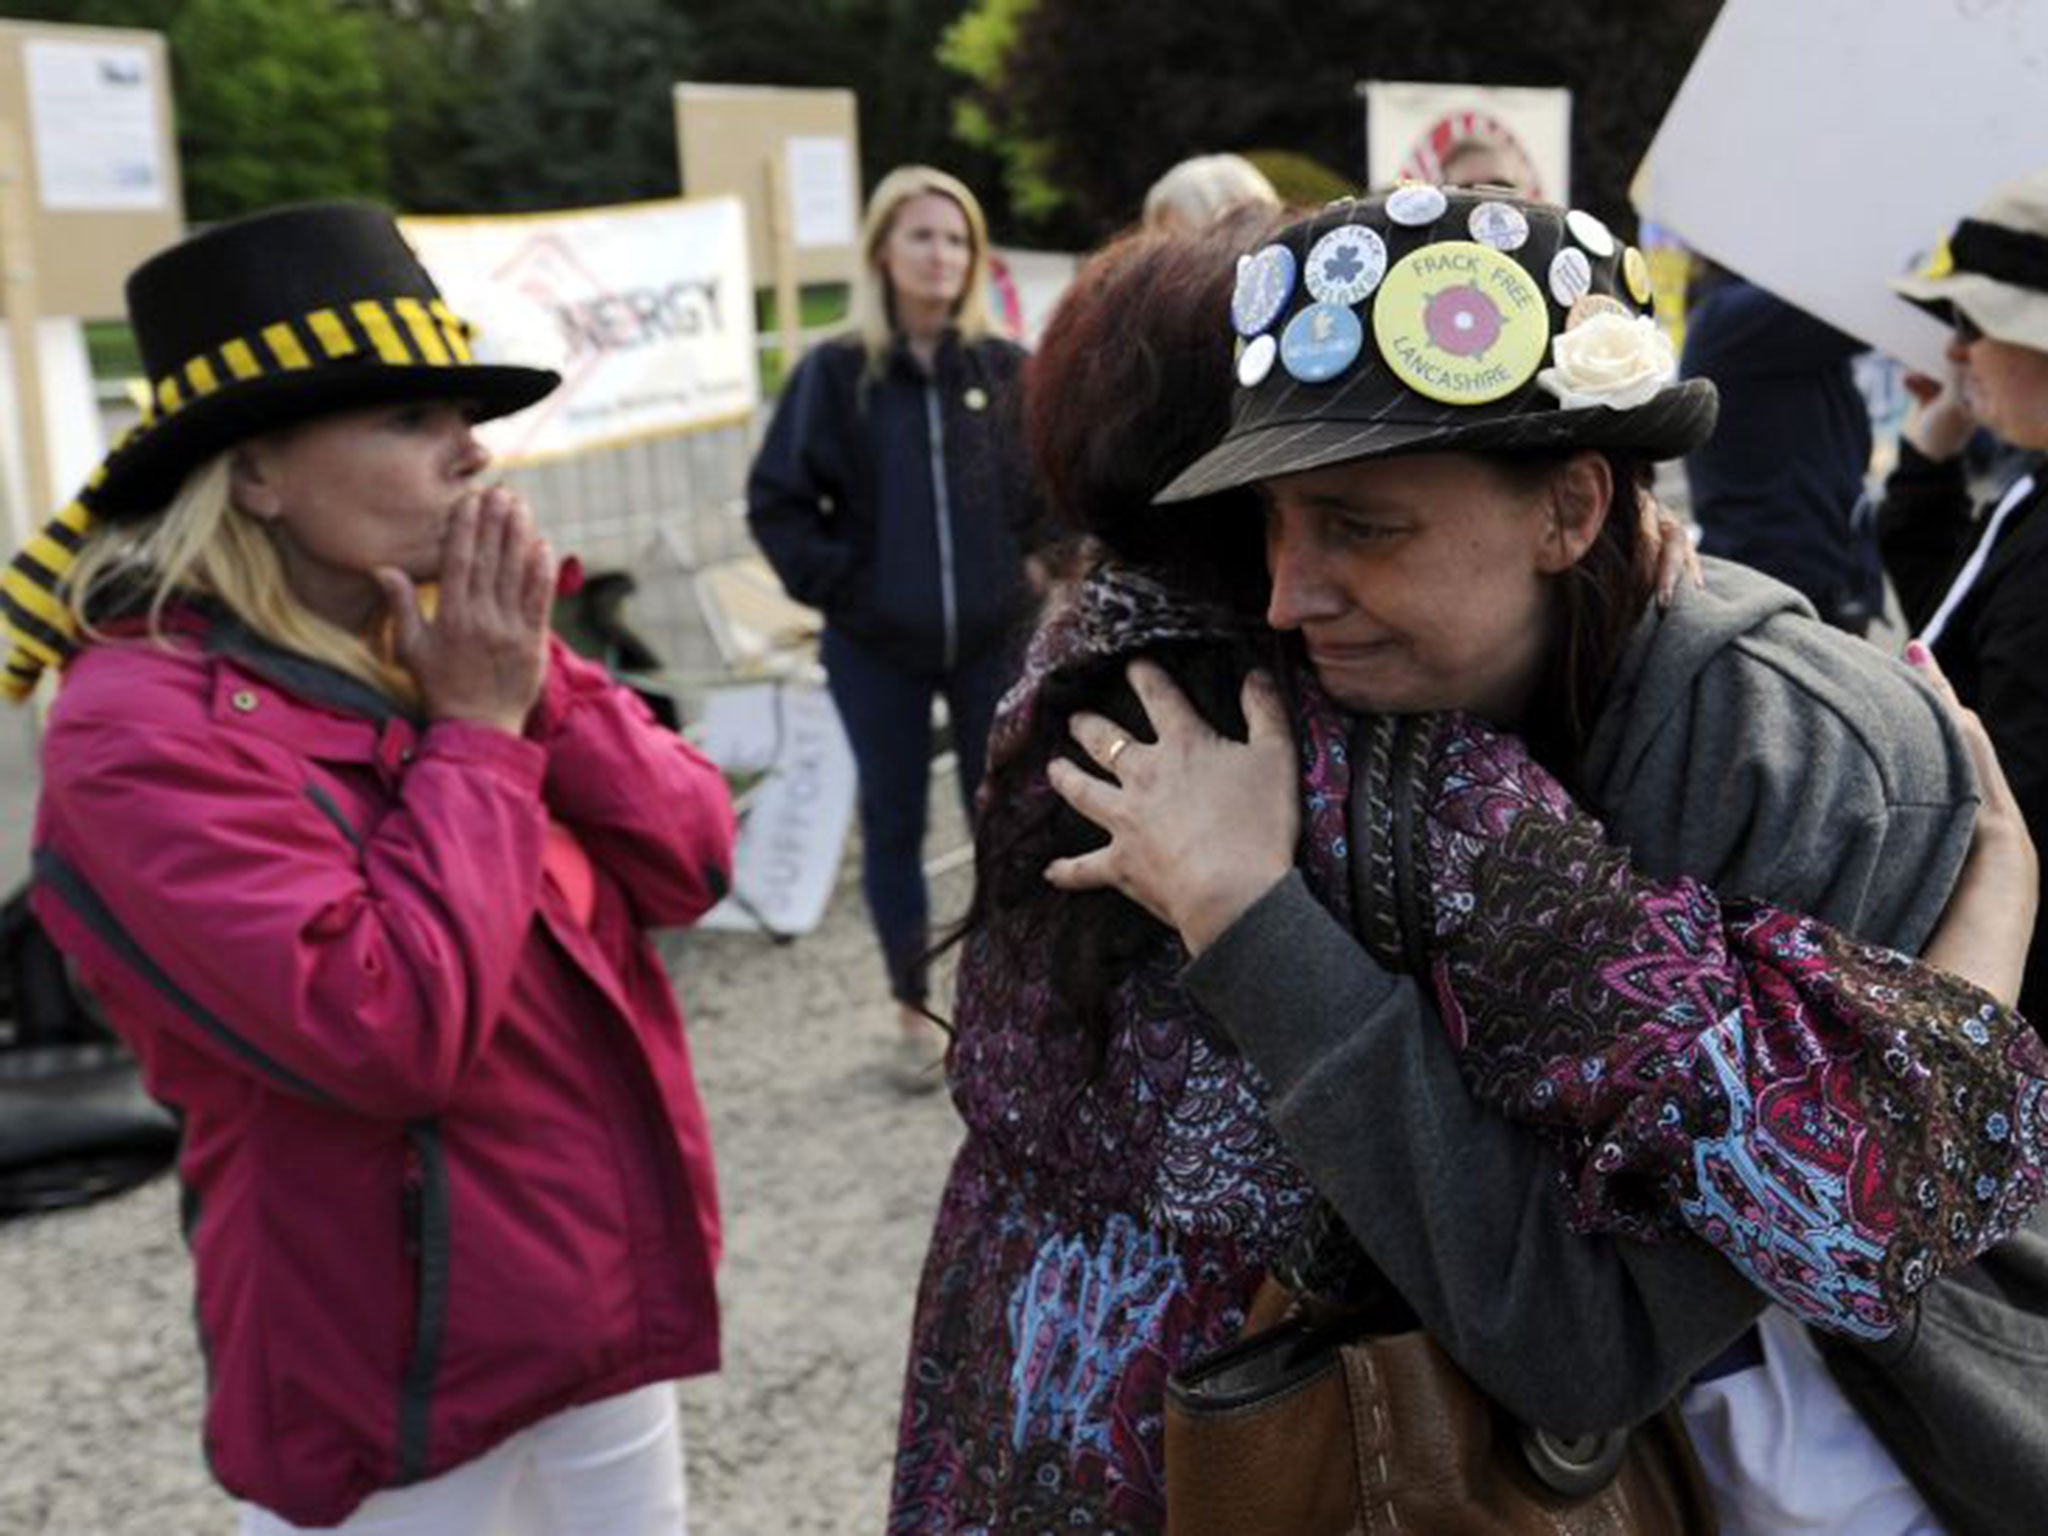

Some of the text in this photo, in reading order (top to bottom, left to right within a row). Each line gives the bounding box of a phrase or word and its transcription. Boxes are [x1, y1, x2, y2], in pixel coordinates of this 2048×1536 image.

[1411, 254, 1482, 277] FRACK
[1491, 266, 1534, 309] FREE
[1393, 335, 1512, 392] LANCASHIRE
